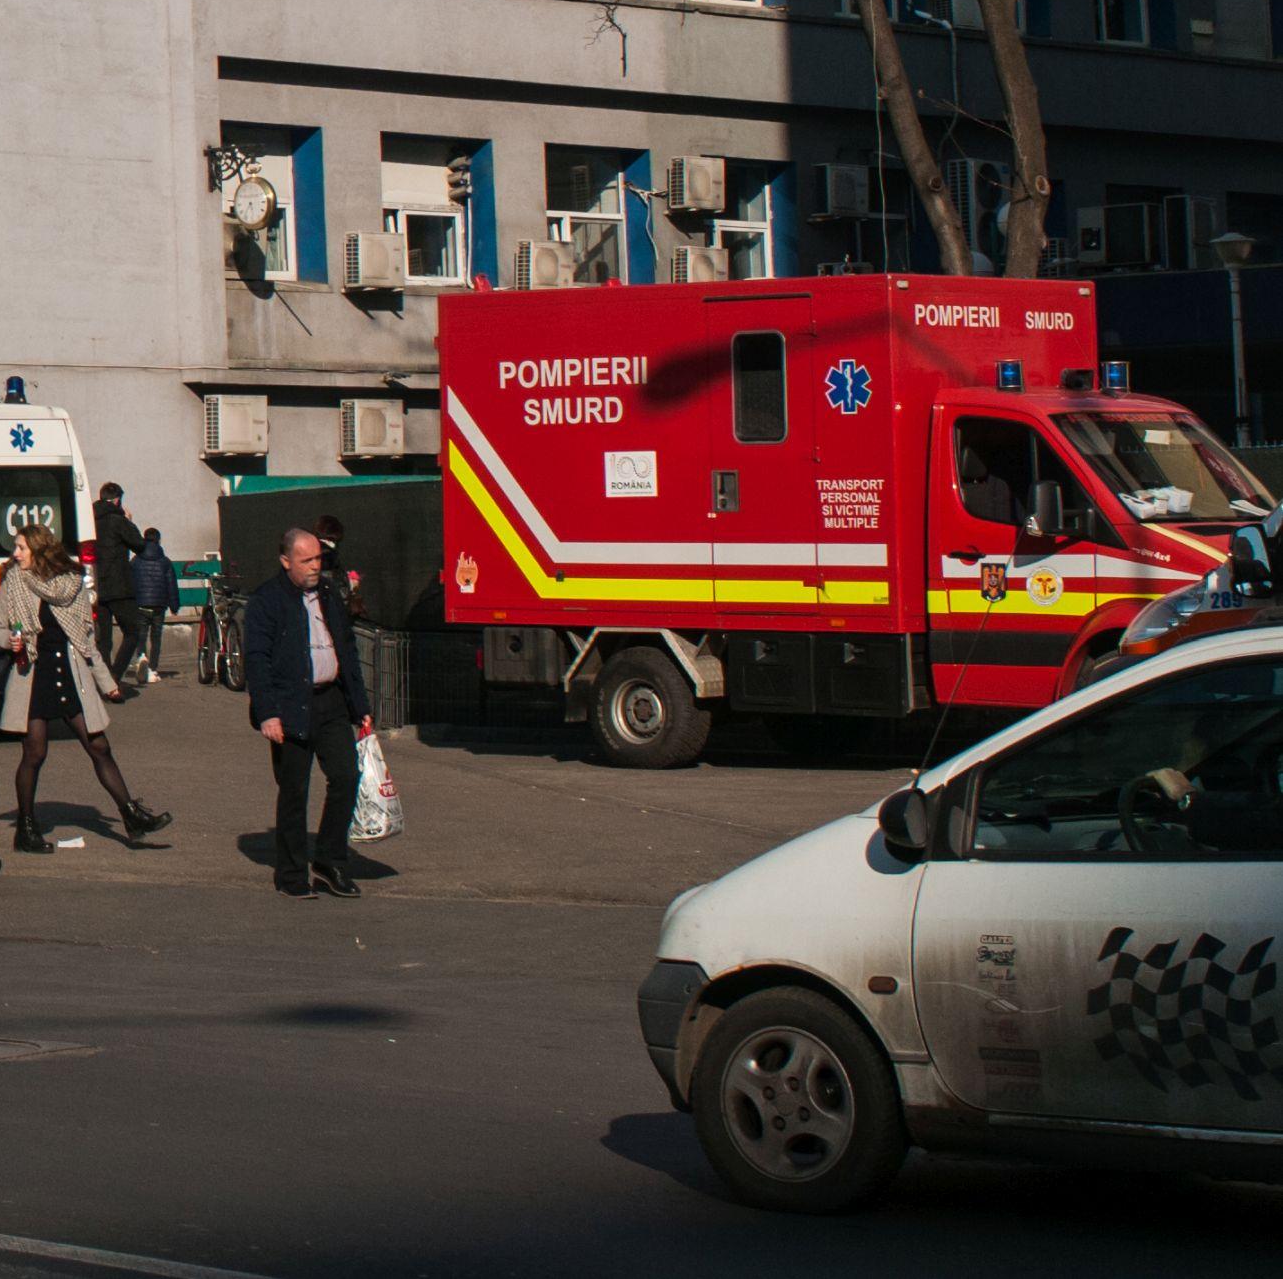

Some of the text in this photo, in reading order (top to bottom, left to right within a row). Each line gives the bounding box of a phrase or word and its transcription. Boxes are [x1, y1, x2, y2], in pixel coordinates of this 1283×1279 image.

[914, 303, 1074, 331] POMPIERII SMURD
[499, 357, 648, 389] POMPIERII
[524, 396, 624, 426] SMURD
[816, 479, 885, 490] TRANSPORT
[820, 492, 881, 503] PERSONAL
[822, 505, 880, 516] SI VICTIME
[824, 517, 879, 529] MULTIPLE
